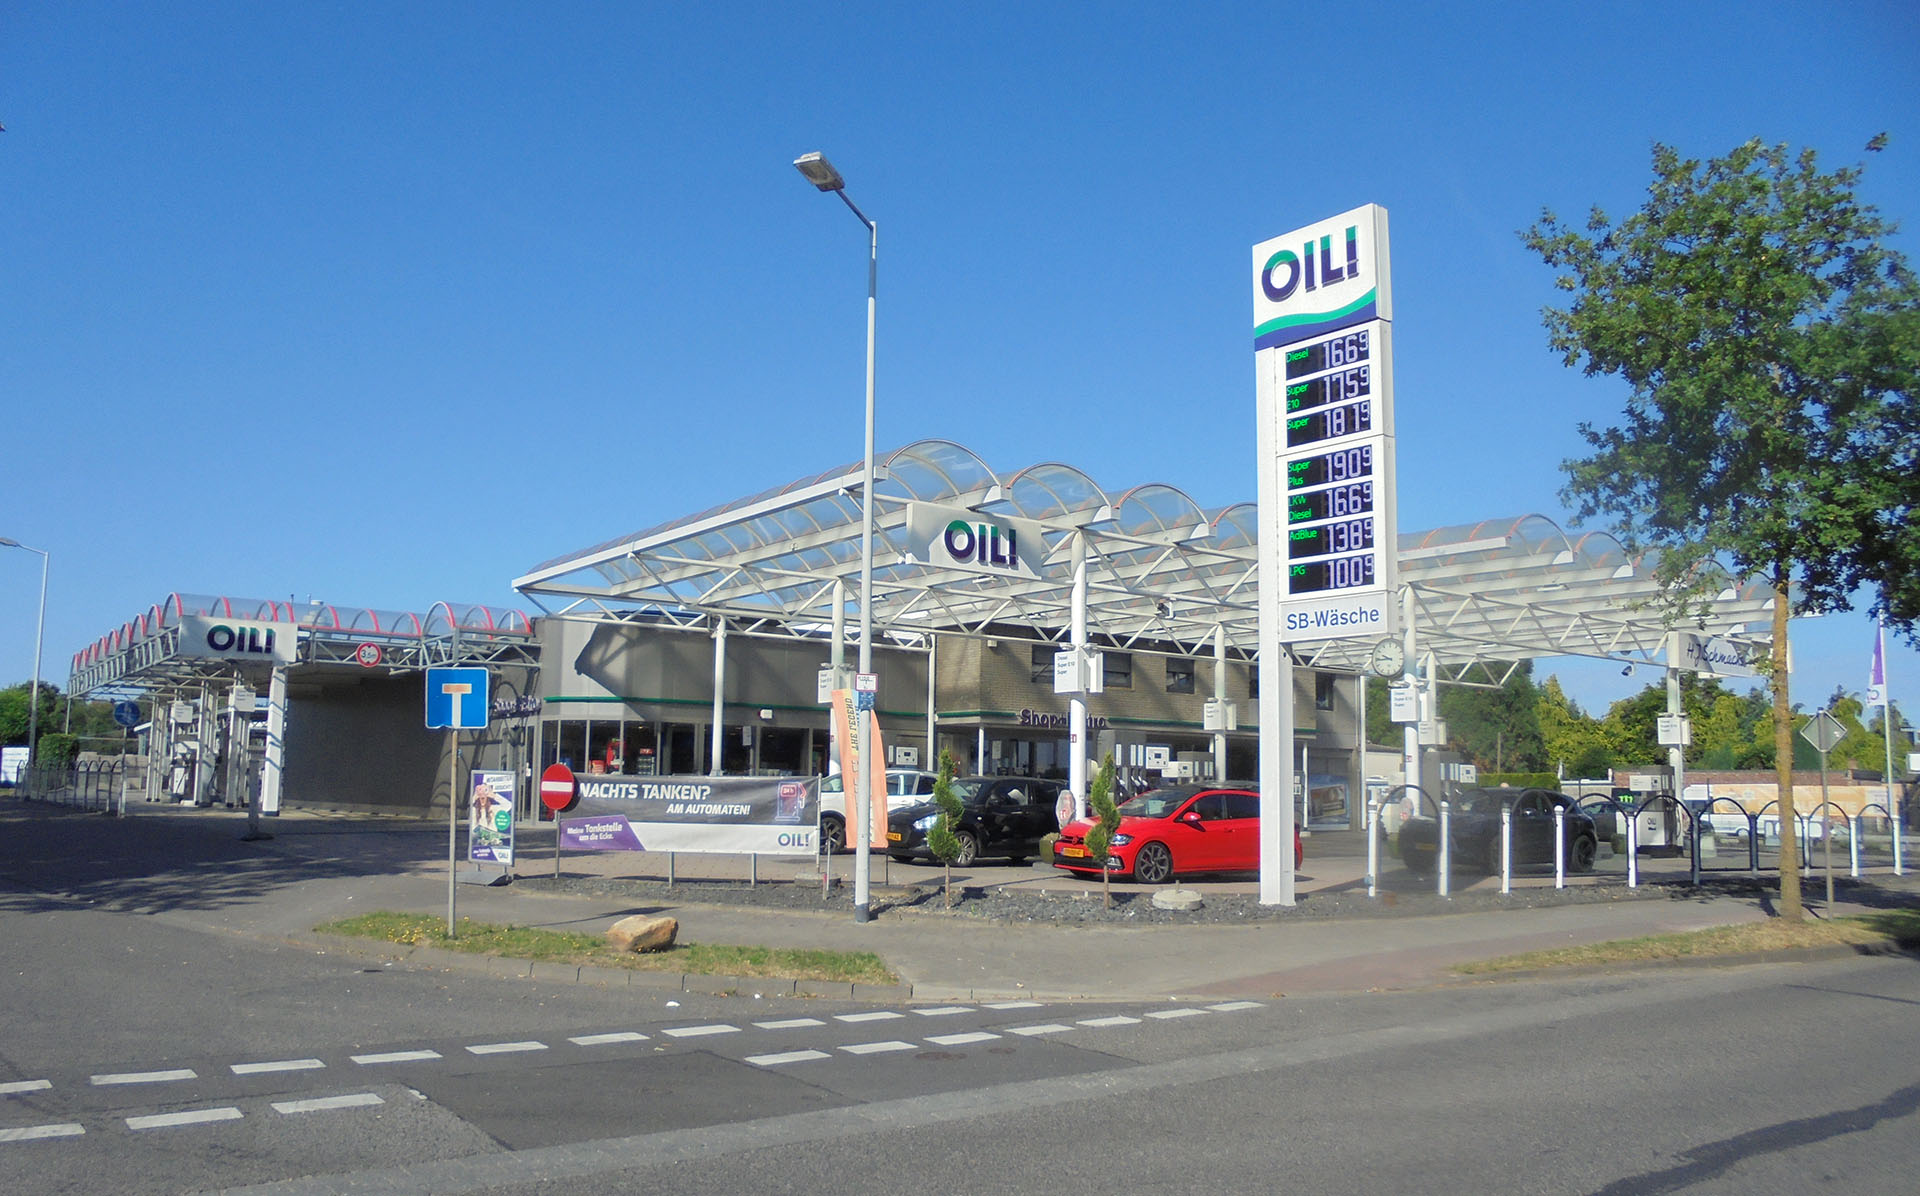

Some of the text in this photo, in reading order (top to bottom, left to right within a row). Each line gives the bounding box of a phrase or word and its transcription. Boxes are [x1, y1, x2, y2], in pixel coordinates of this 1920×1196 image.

[1261, 225, 1359, 302] OIL!
[1286, 331, 1369, 369] Diesel 1669
[1286, 366, 1370, 404] Super 1759
[1287, 398, 1300, 411] E10
[1287, 401, 1370, 438] Super 1819
[1288, 446, 1372, 482] Super 1909
[1288, 476, 1304, 488] Plus
[1288, 482, 1373, 518] LKW 1669
[1289, 508, 1312, 521] Diesel
[944, 520, 1018, 570] OIL!
[1289, 519, 1373, 553] AdBlue 1389
[1289, 555, 1374, 589] LPG 1009
[1287, 606, 1380, 631] SB-Wäsche
[207, 624, 275, 653] OIL!
[579, 782, 711, 800] NACHTS TANKEN?
[666, 803, 750, 815] AM AUTOMATEN!
[585, 822, 622, 833] Tankstelle
[777, 833, 808, 847] OIL!
